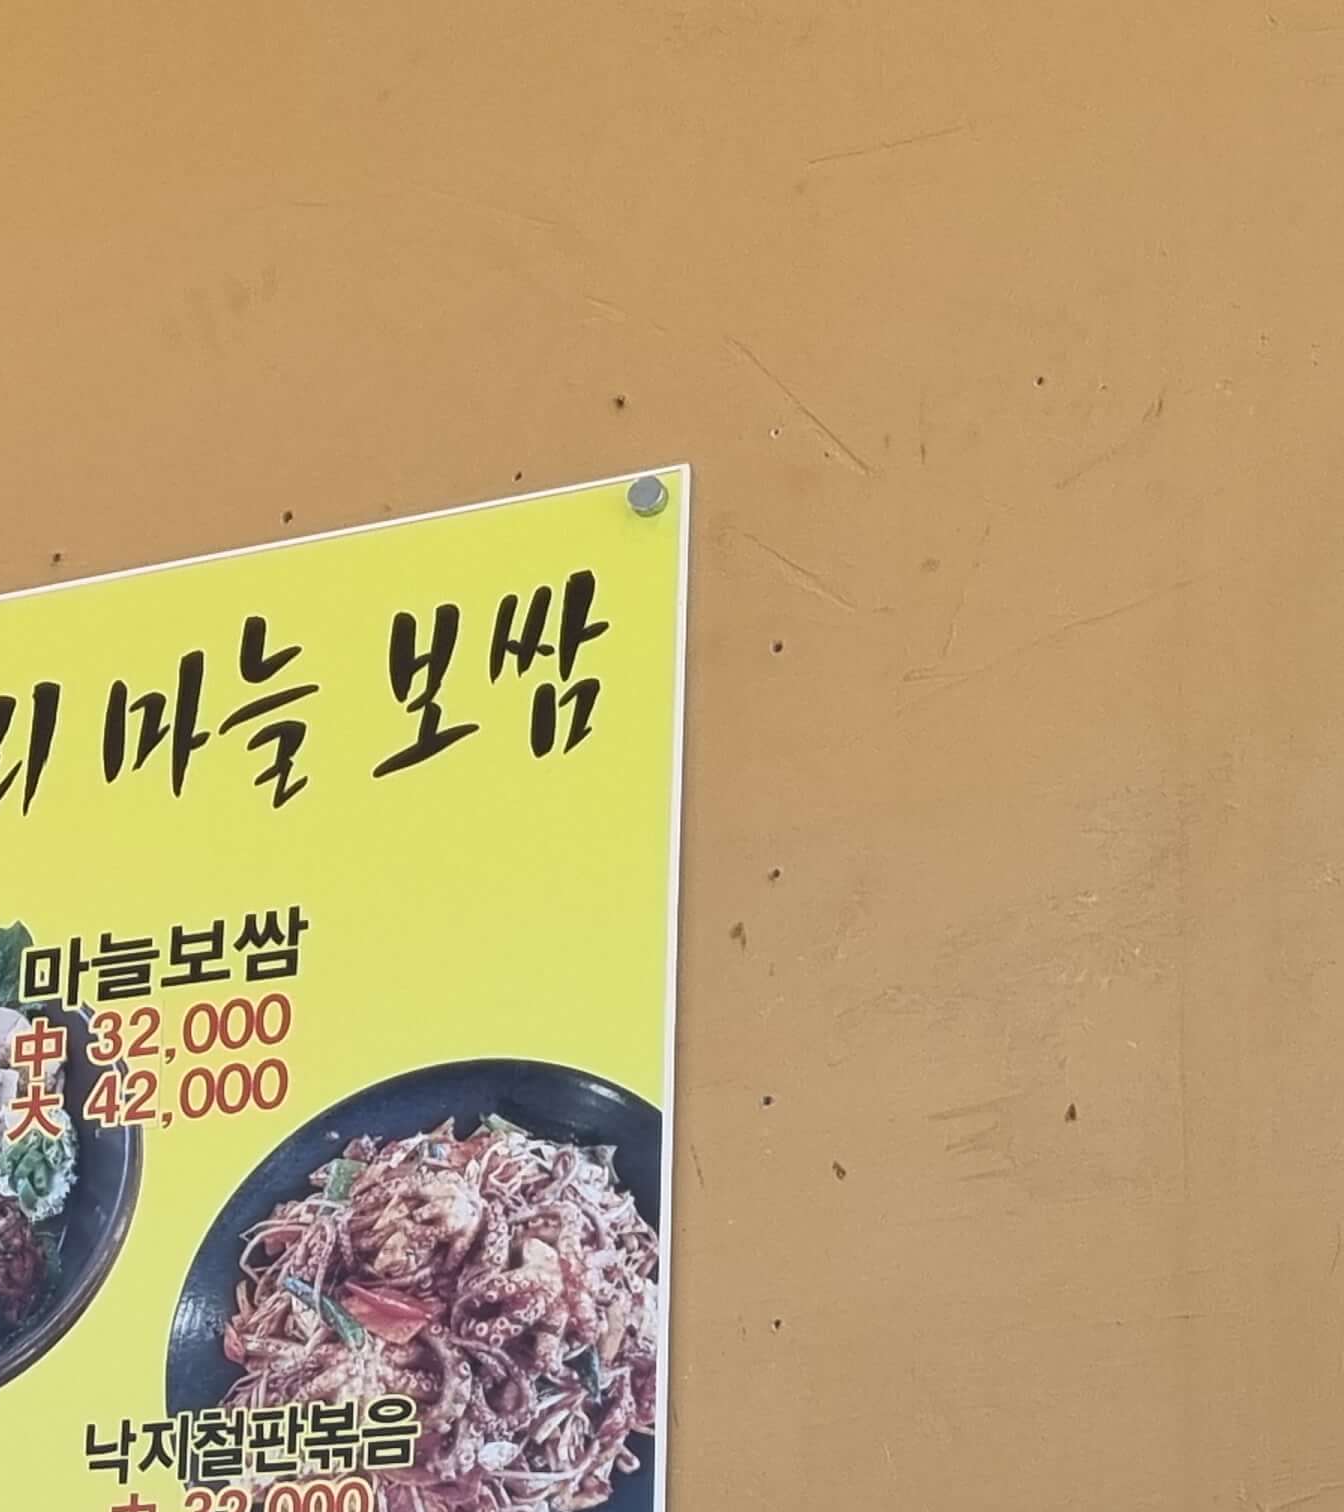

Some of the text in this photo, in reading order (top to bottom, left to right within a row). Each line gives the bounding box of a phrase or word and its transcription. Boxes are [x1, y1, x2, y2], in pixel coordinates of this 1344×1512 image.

[103, 614, 320, 809] 마늘
[372, 568, 611, 780] 보쌈
[22, 905, 309, 1006] 마늘보쌈
[14, 992, 292, 1079] 中 32,000
[7, 1058, 289, 1141] 大 42,000
[85, 1397, 419, 1485] 낙지철판볶음
